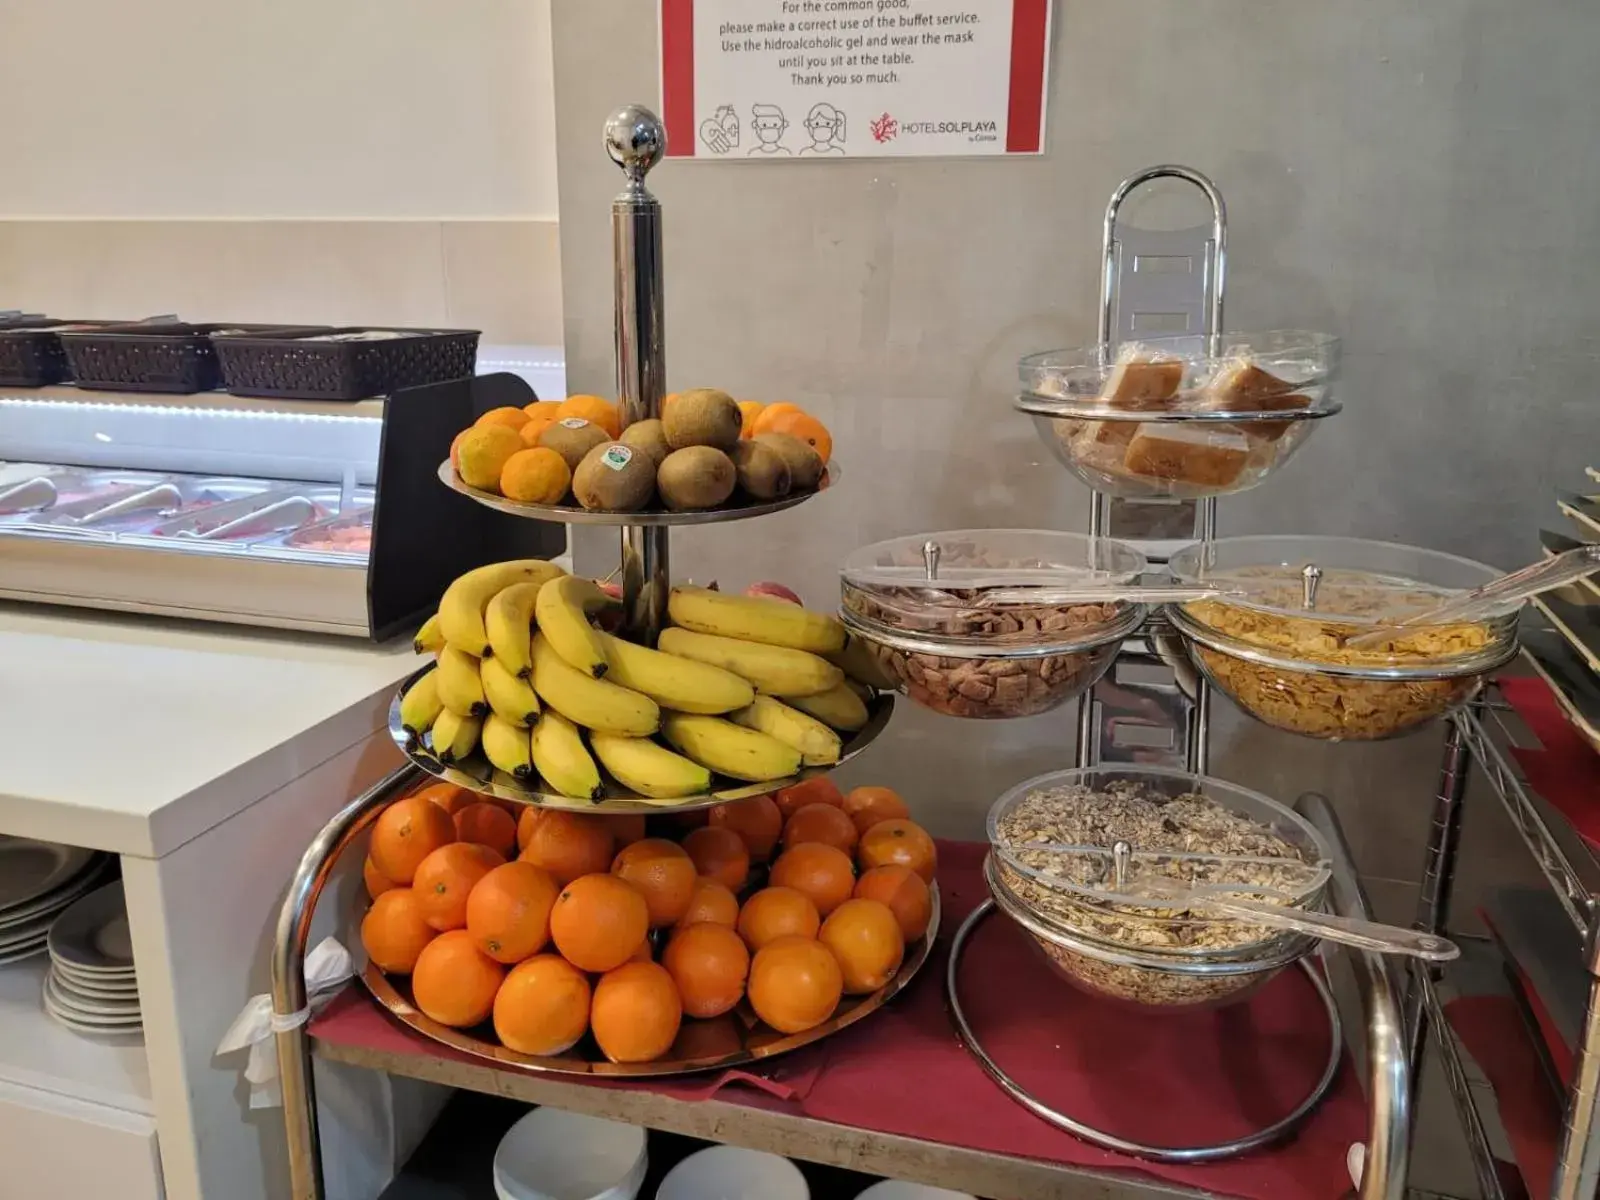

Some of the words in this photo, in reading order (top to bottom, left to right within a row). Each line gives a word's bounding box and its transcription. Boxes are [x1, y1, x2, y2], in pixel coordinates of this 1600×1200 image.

[782, 1, 800, 13] For
[803, 0, 821, 12] the
[824, 0, 873, 12] common
[877, 0, 910, 12] good,
[719, 21, 754, 36] please
[756, 20, 786, 32] make
[788, 21, 795, 32] a
[798, 19, 837, 31] correct
[840, 19, 859, 30] use
[862, 16, 875, 29] of
[877, 16, 896, 28] the
[899, 14, 933, 27] buffet
[936, 12, 981, 26] service.
[721, 40, 742, 52] Use
[744, 38, 762, 51] the
[764, 36, 842, 50] hidroalcoholic
[846, 35, 864, 51] gel
[866, 33, 888, 46] and
[891, 33, 918, 46] wear
[921, 32, 941, 45] the
[943, 29, 974, 43] mask
[778, 55, 804, 68] until
[807, 57, 827, 70] you
[830, 55, 843, 67] sit
[846, 55, 858, 66] at
[861, 53, 879, 66] the
[882, 52, 914, 65] table.
[790, 73, 824, 86] Thank
[827, 74, 847, 88] you
[850, 73, 863, 84] so
[901, 121, 996, 134] HOTELSOLPLAYA
